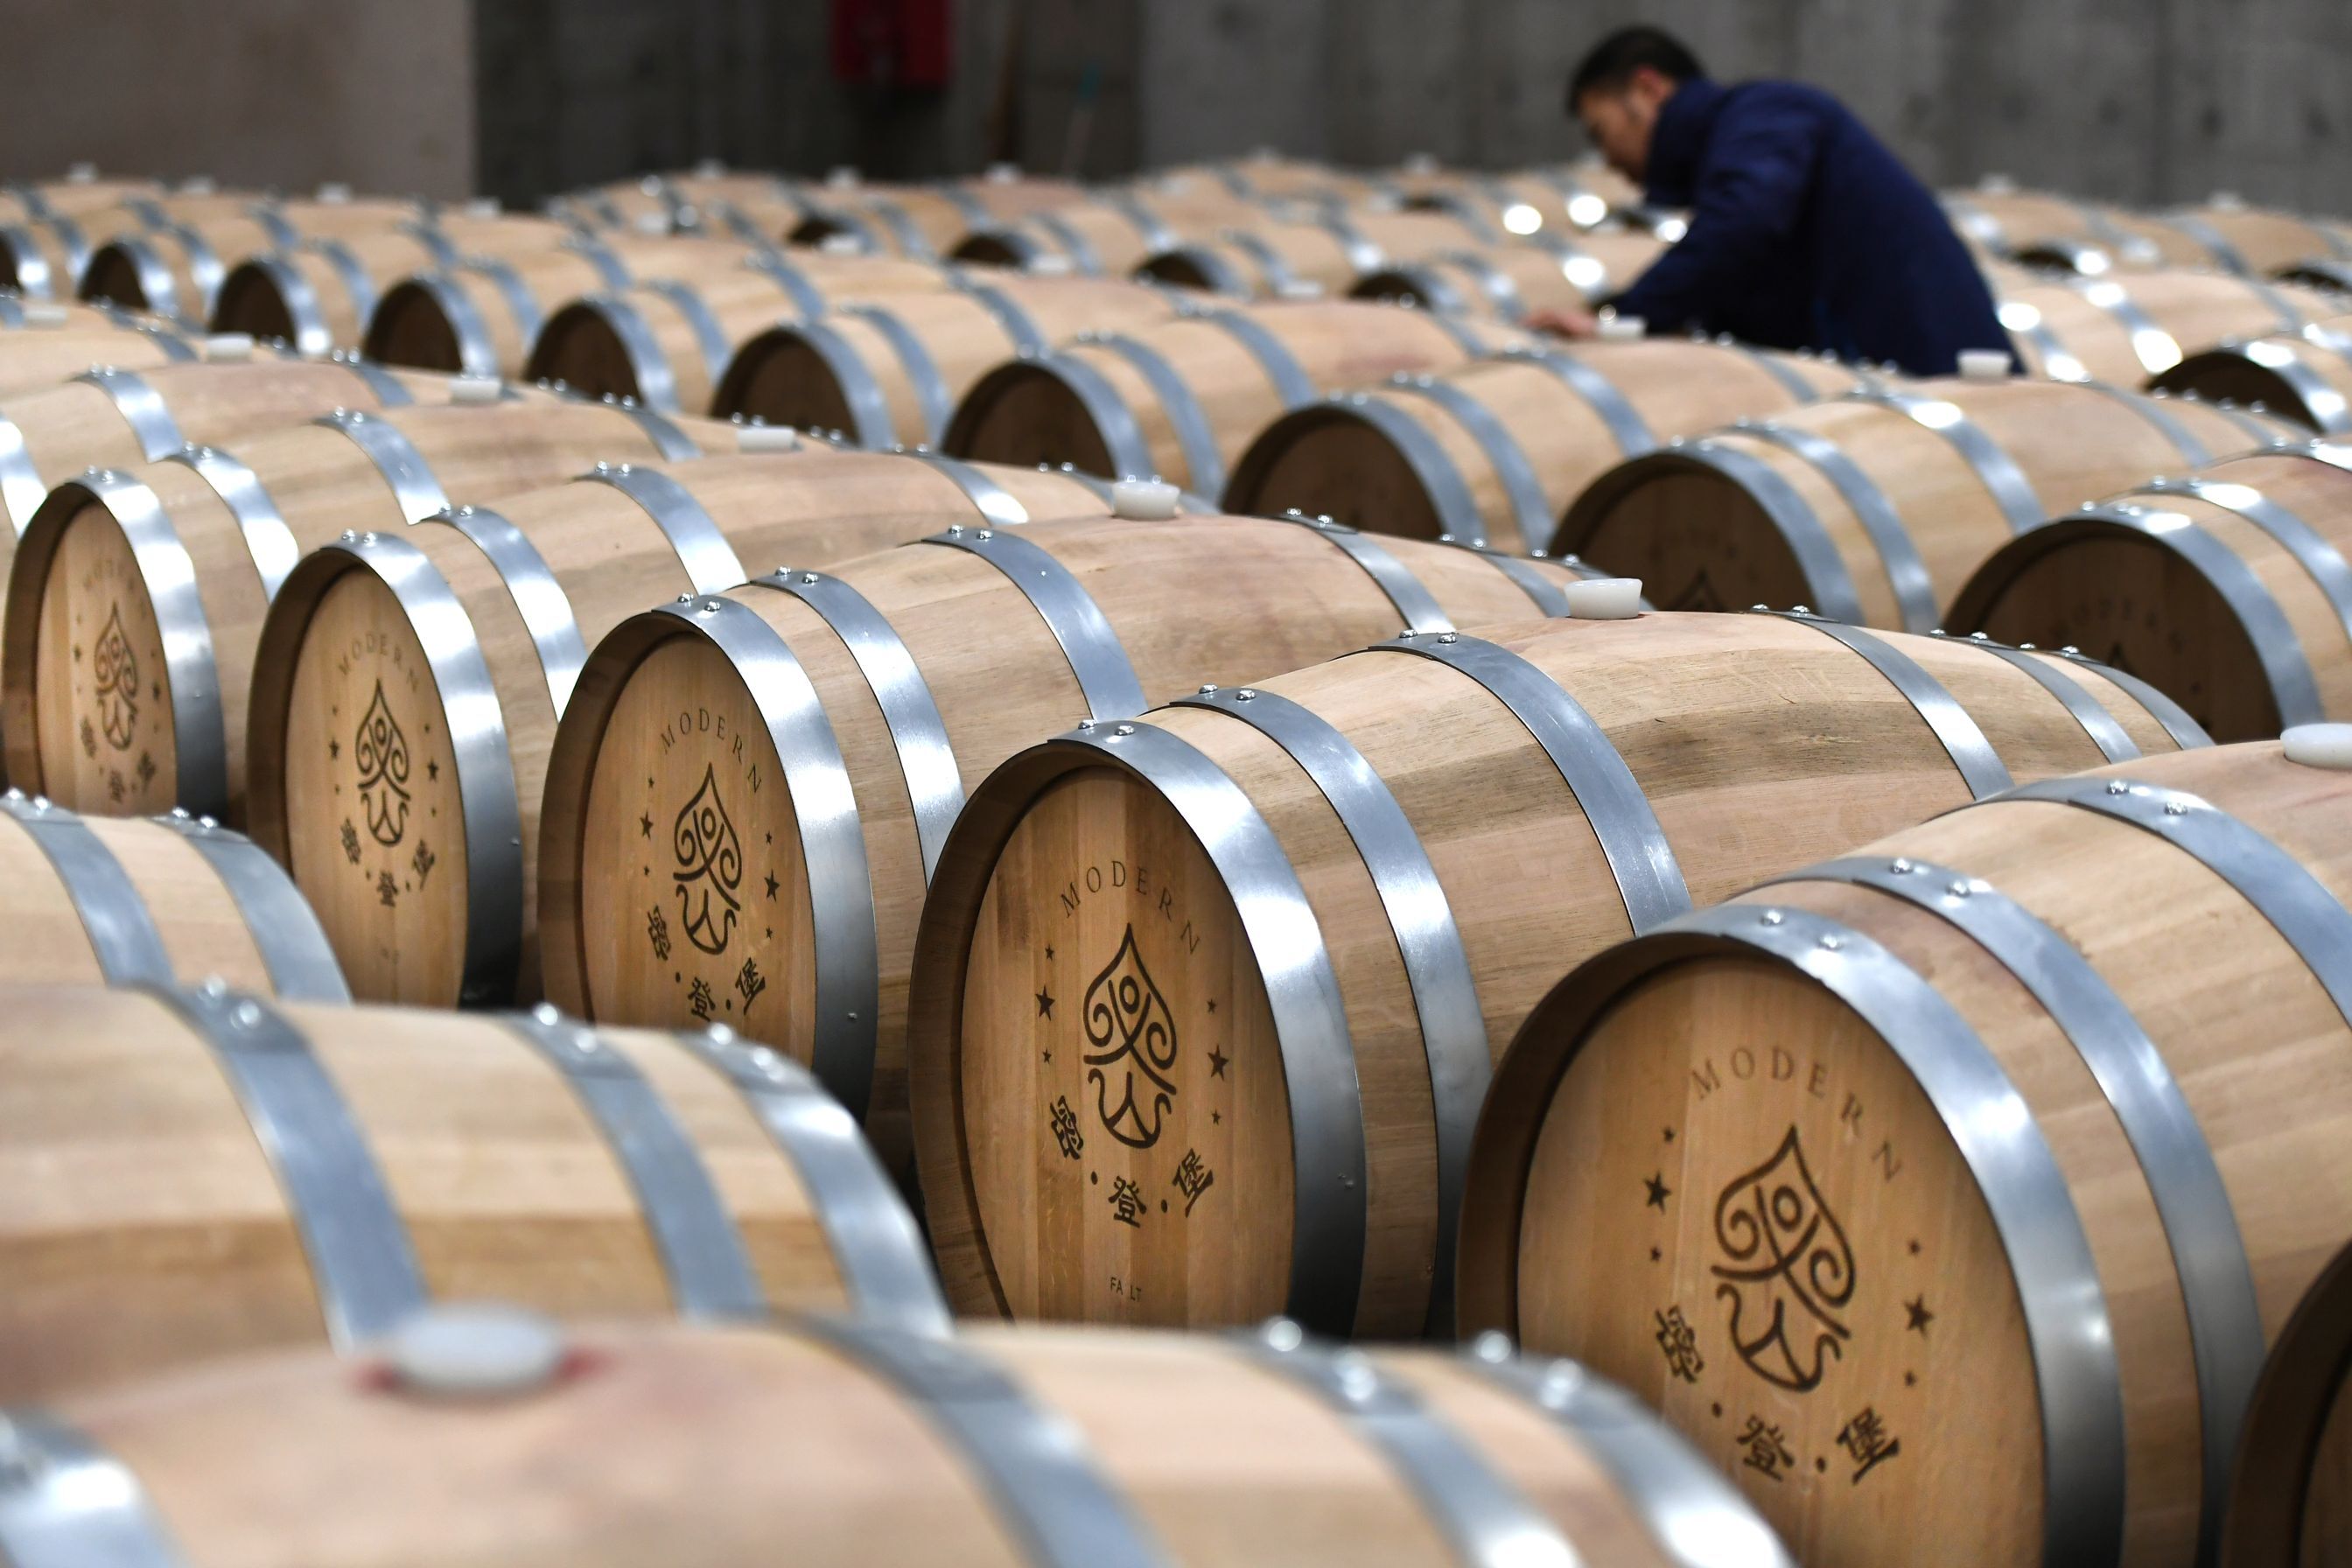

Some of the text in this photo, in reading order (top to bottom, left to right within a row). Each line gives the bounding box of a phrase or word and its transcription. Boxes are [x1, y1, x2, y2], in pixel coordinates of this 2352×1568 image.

[661, 708, 762, 794] MODERN
[1060, 860, 1201, 955] MODERN
[1691, 1047, 1900, 1181] MODERN
